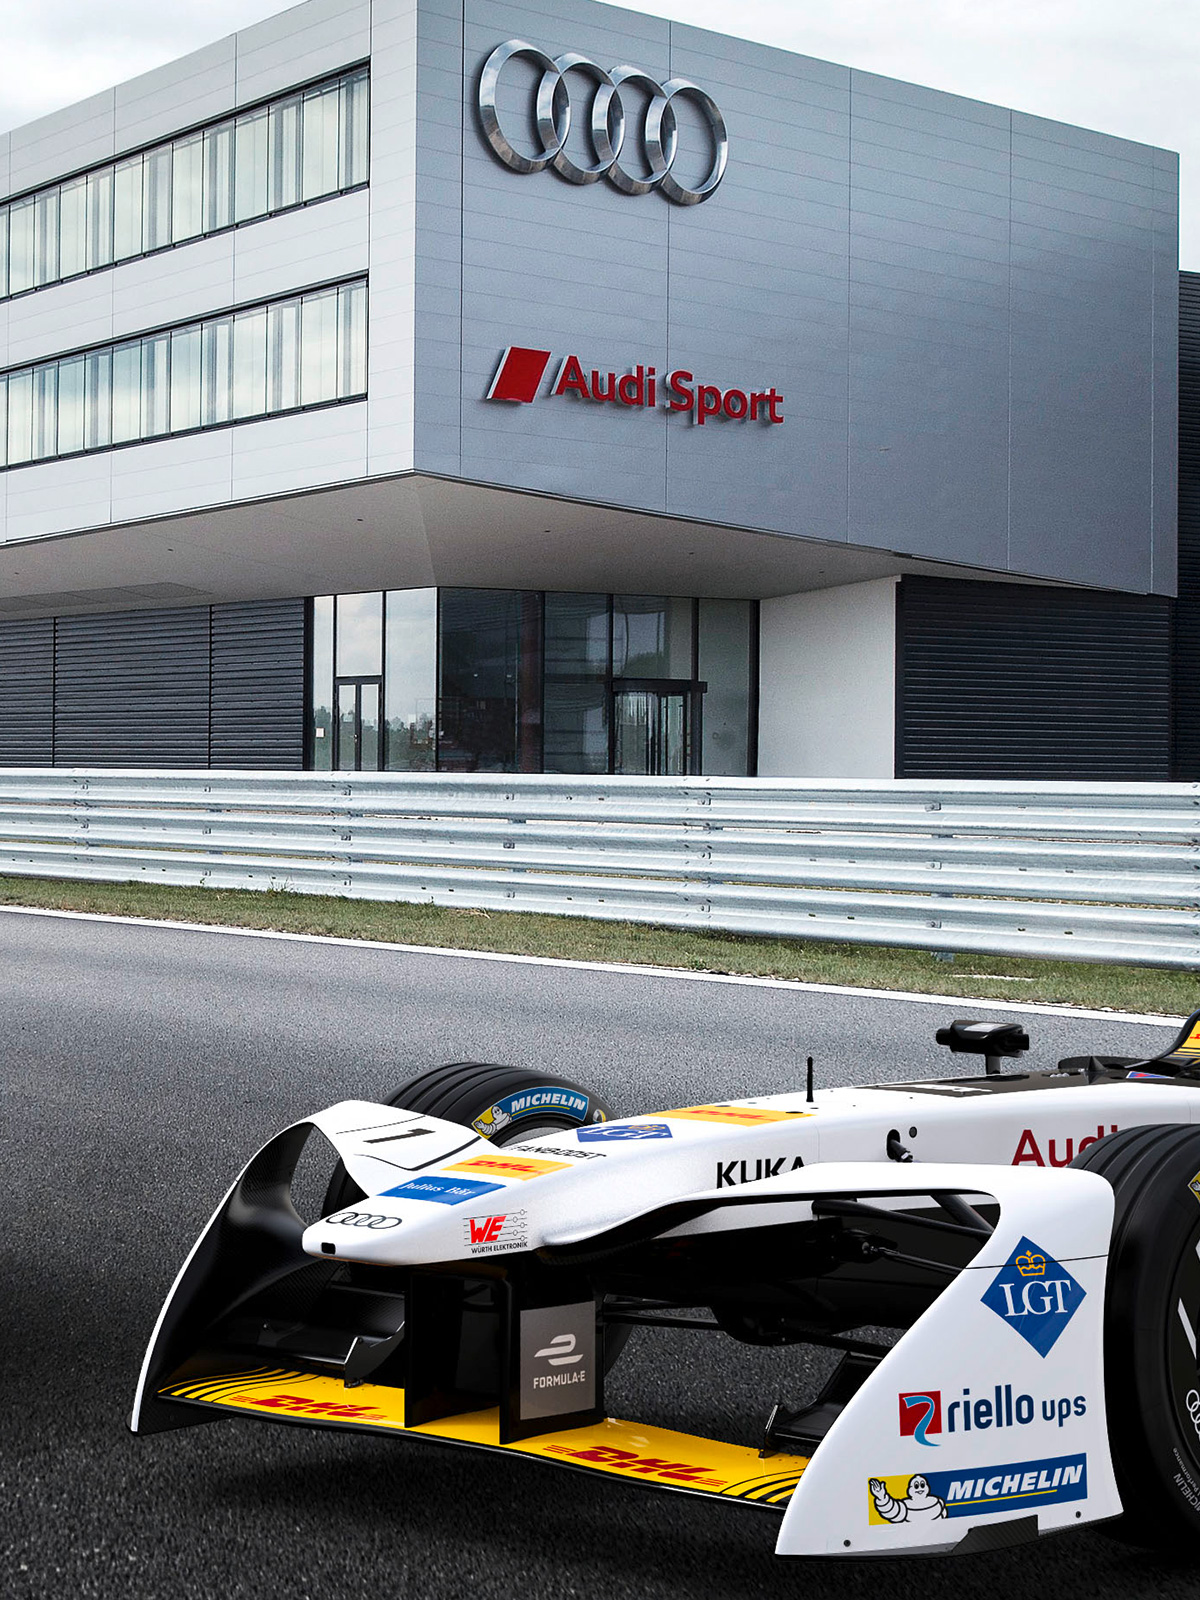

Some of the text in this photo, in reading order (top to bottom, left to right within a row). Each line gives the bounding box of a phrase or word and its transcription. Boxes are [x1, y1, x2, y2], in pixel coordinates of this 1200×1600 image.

[551, 355, 784, 426] Audi Sport
[511, 1093, 586, 1113] MICHELIN
[1011, 1125, 1118, 1168] Au
[467, 1160, 536, 1172] DHL
[399, 1181, 475, 1196] Julius Bär
[470, 1215, 507, 1244] WE
[471, 1242, 528, 1254] WÜRTH ELEKTRONIK
[998, 1279, 1072, 1318] LGT
[247, 1394, 377, 1419] DHL
[948, 1384, 1087, 1433] riello ups
[568, 1446, 717, 1482] DHL
[947, 1464, 1084, 1501] MICHELIN
